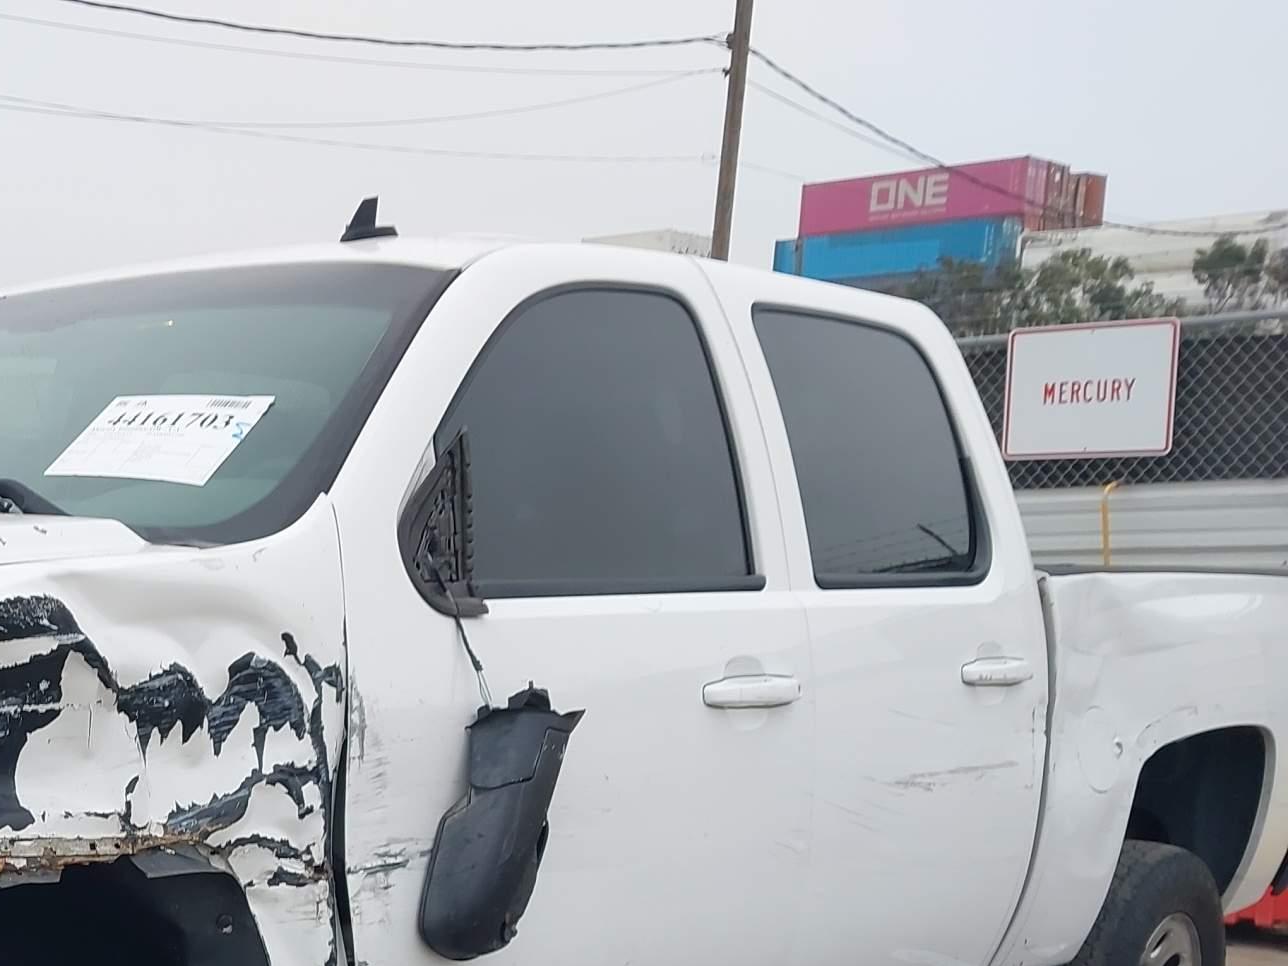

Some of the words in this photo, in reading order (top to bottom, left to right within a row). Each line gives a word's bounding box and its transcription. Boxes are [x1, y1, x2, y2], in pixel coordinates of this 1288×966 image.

[869, 172, 950, 213] ONE
[1043, 377, 1137, 406] MERCURY
[108, 411, 235, 430] 44161703
